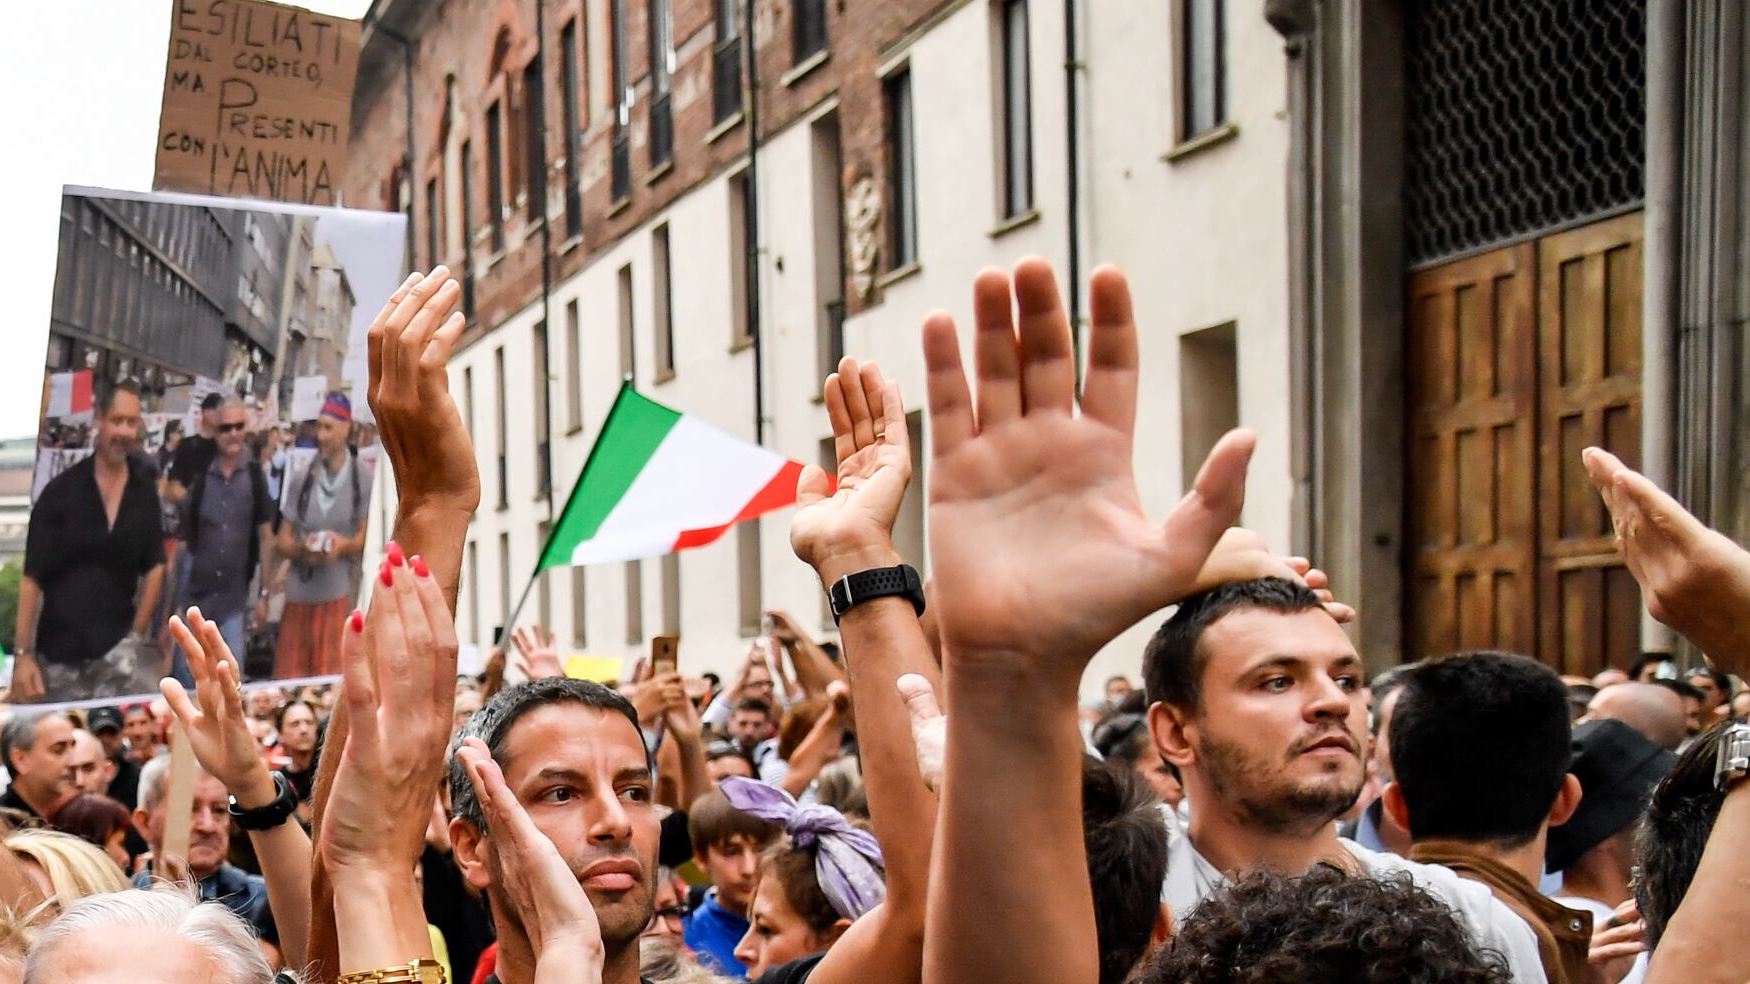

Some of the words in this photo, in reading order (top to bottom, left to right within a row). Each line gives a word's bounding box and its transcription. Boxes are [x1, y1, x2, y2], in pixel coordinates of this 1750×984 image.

[179, 0, 342, 64] ESILIATI
[173, 38, 213, 63] DAL
[233, 51, 323, 90] CORTEO,
[171, 71, 205, 92] MA
[218, 78, 337, 144] PRESENTI
[163, 132, 206, 156] CON
